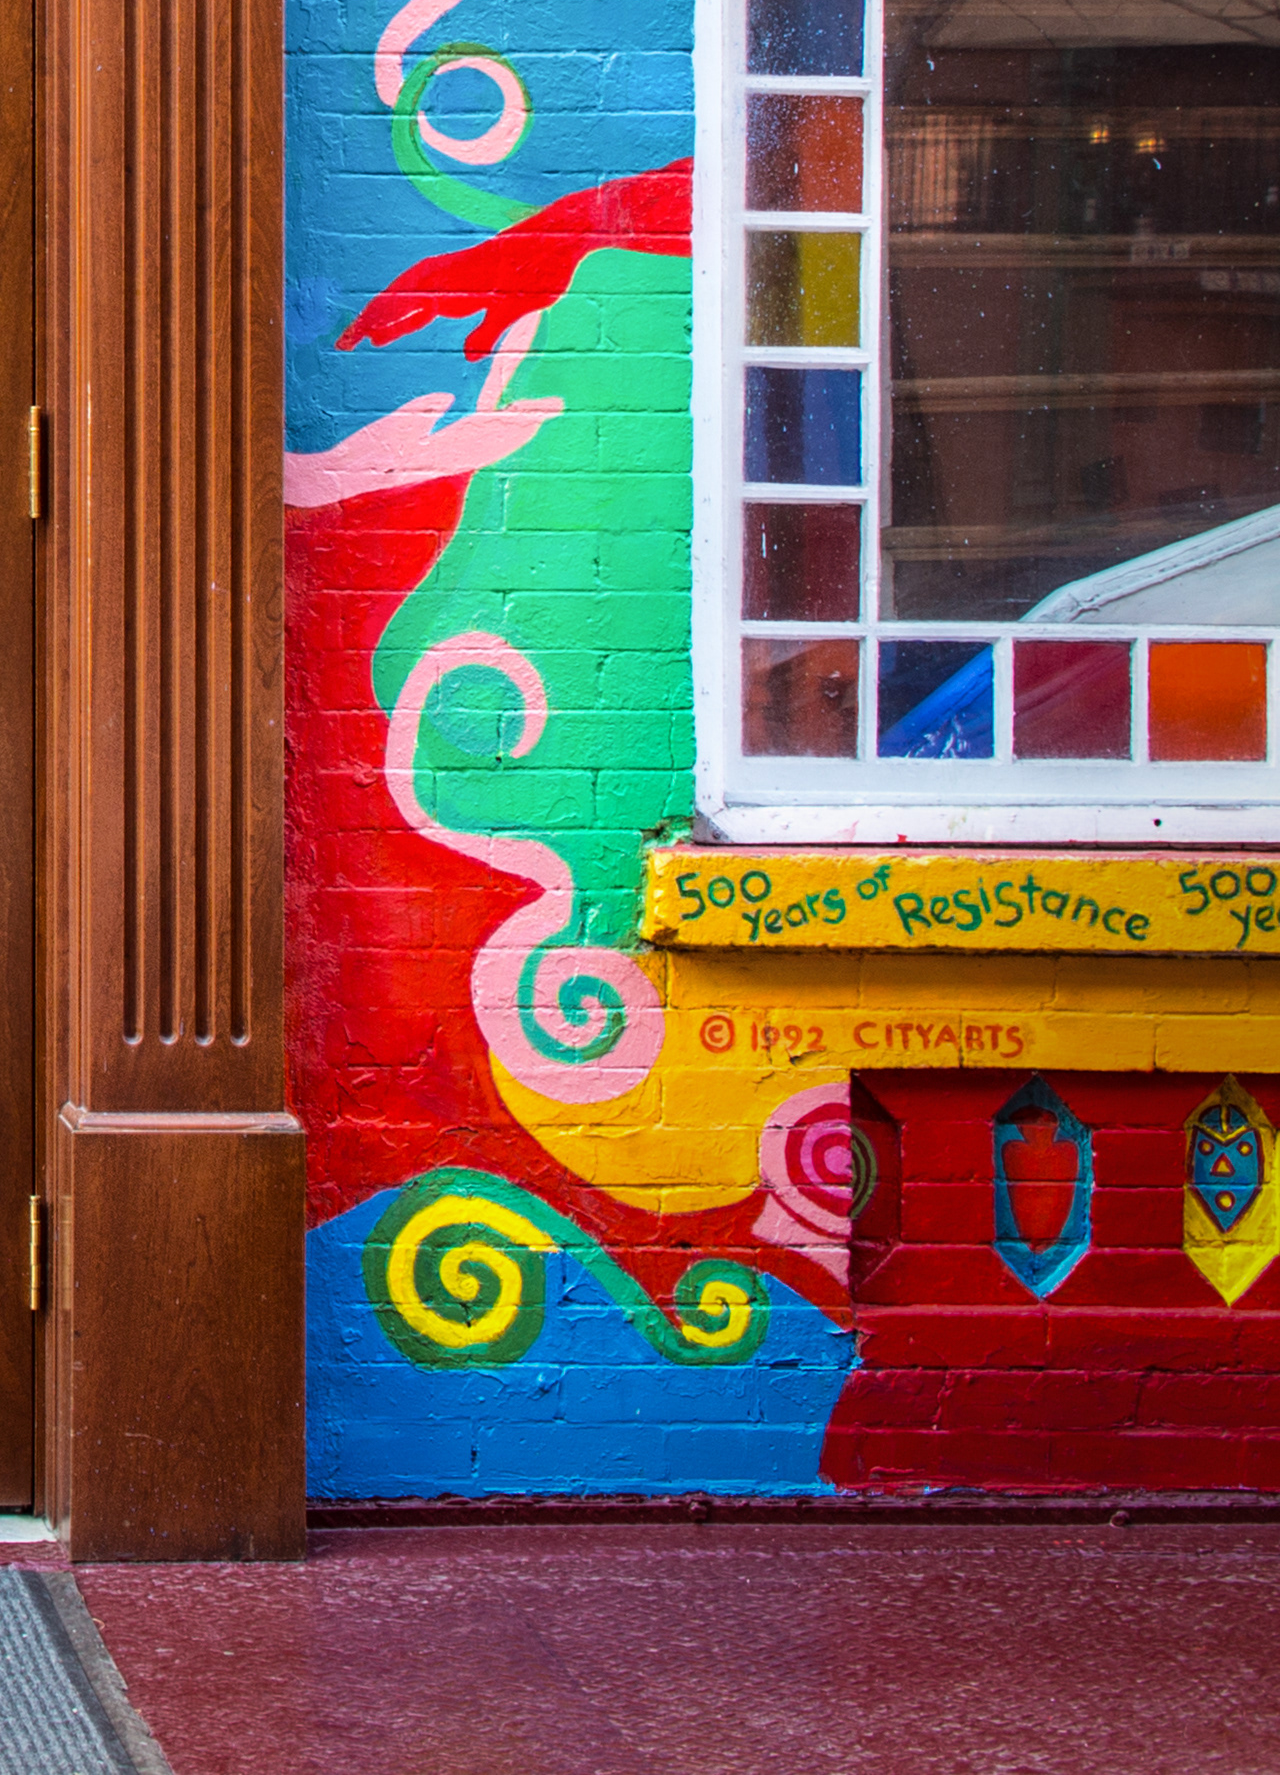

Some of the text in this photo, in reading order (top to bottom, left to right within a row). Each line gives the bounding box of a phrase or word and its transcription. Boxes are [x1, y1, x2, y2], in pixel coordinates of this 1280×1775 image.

[676, 864, 1151, 943] 500 years of Resistance
[1180, 866, 1280, 948] 500 ye
[750, 1021, 828, 1053] 1992
[852, 1020, 1025, 1058] CITYARTS
